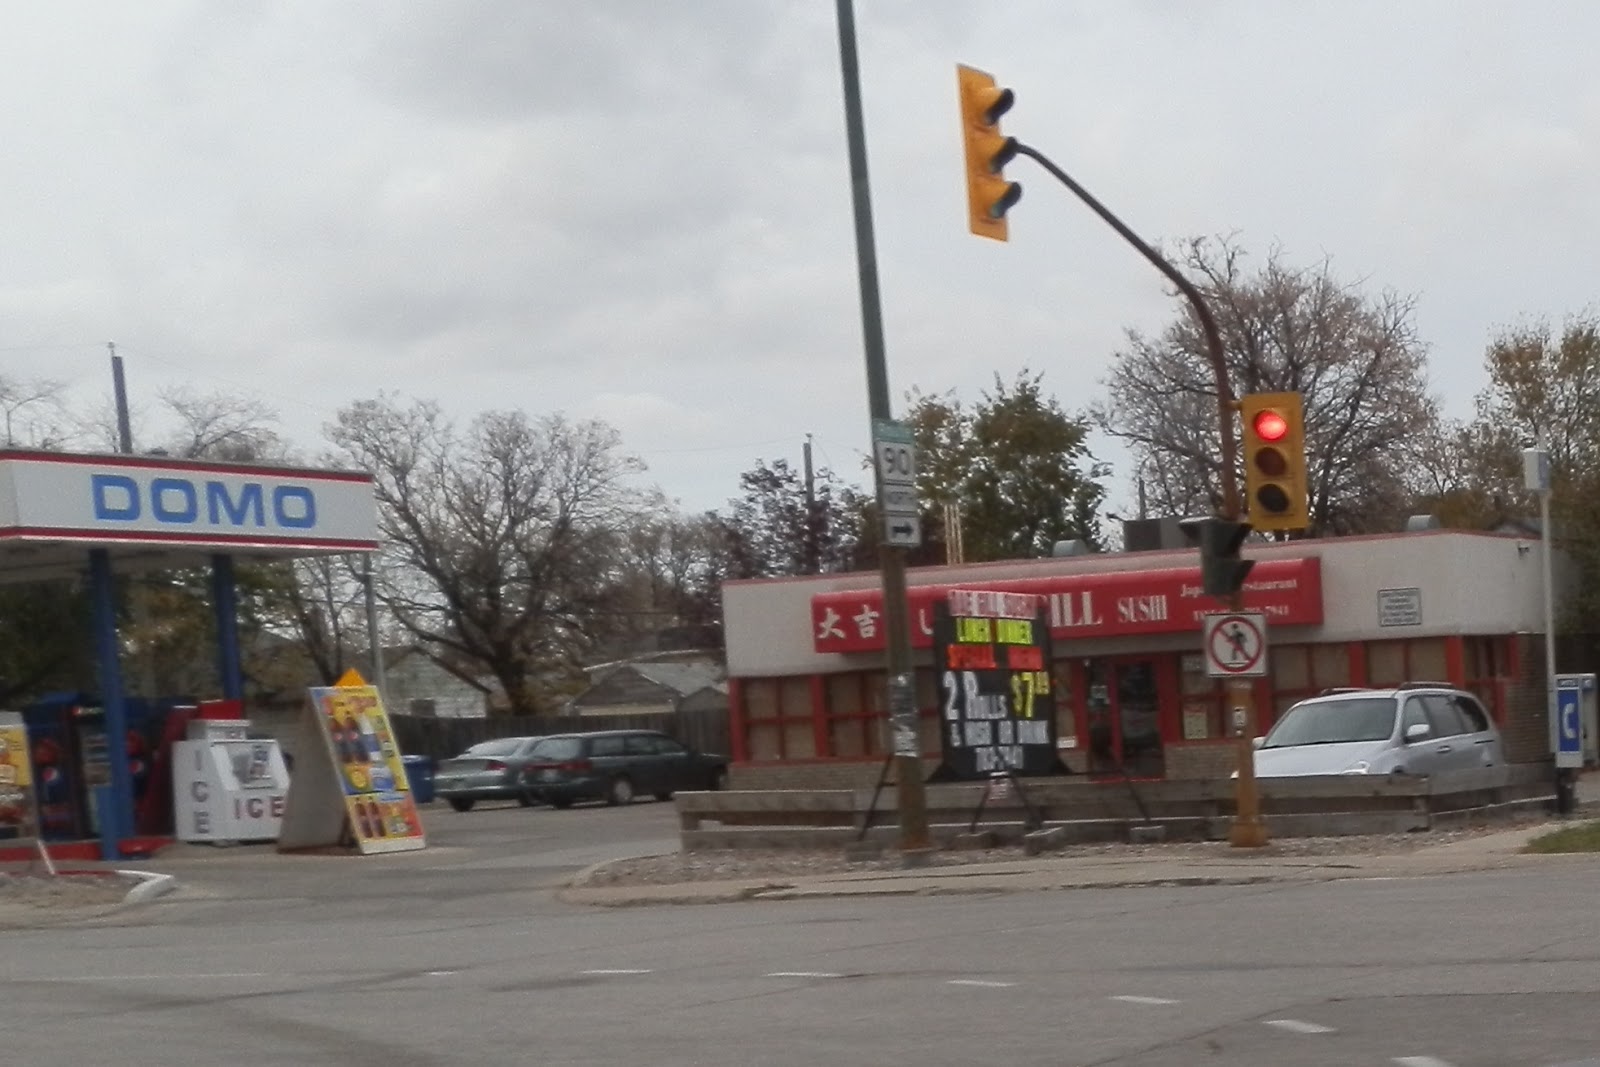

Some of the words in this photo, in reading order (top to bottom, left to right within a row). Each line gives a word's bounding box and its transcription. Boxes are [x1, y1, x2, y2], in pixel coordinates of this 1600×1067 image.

[885, 446, 911, 475] 90
[91, 474, 317, 529] DOMO
[1049, 591, 1103, 628] ILL
[1117, 594, 1168, 623] SUSHI
[943, 670, 960, 720] 2
[190, 749, 211, 834] ICE
[233, 795, 285, 820] ICE
